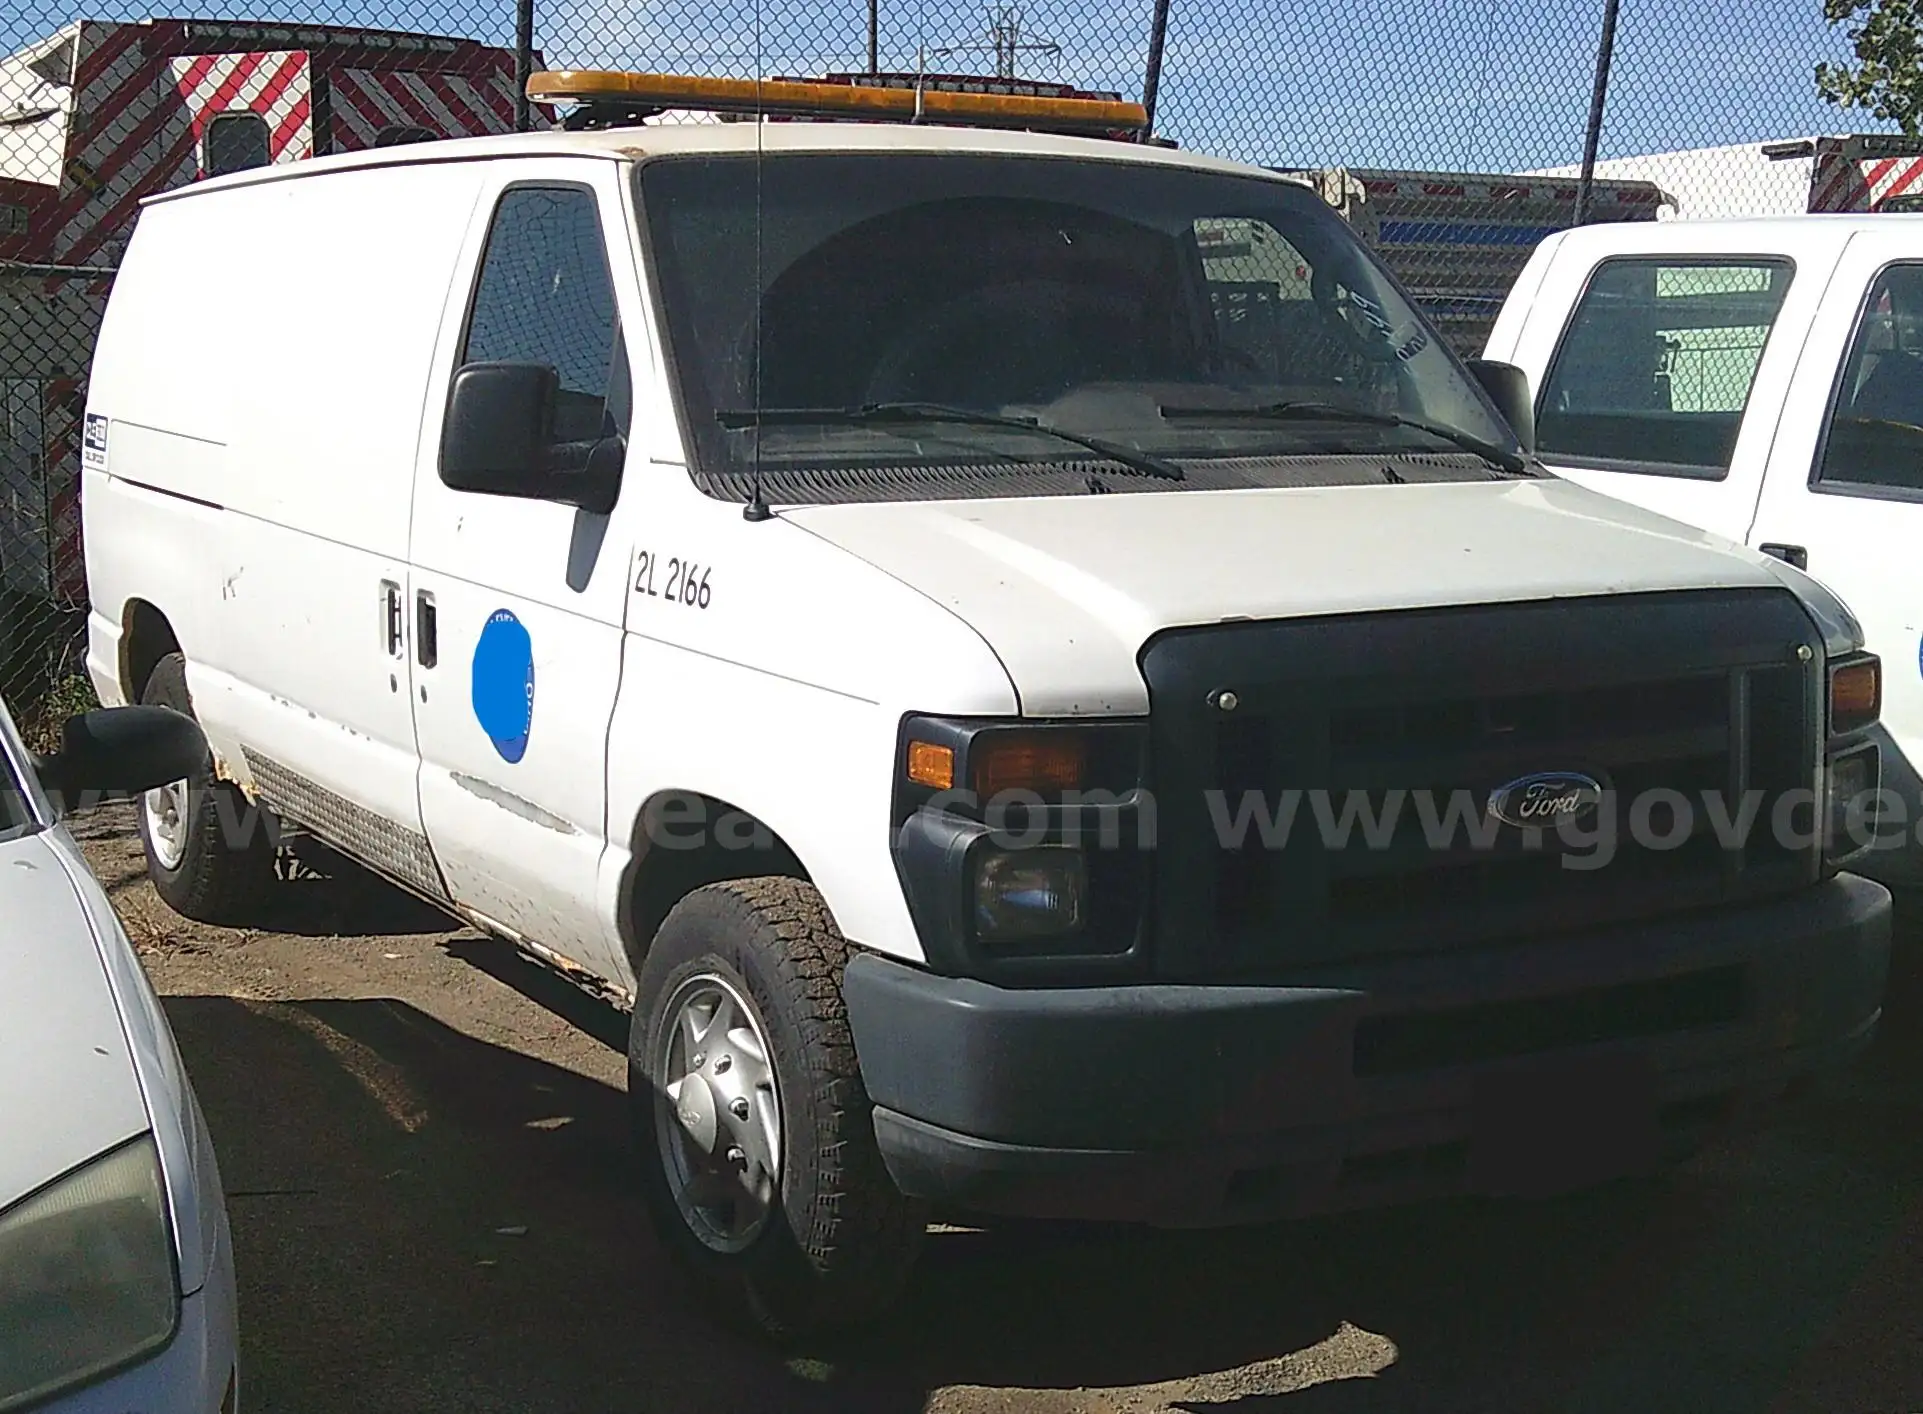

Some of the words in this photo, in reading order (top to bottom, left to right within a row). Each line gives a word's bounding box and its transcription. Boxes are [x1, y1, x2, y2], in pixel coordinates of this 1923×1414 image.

[635, 550, 657, 597] 2L
[664, 557, 711, 610] 2166
[1519, 782, 1581, 818] Ford
